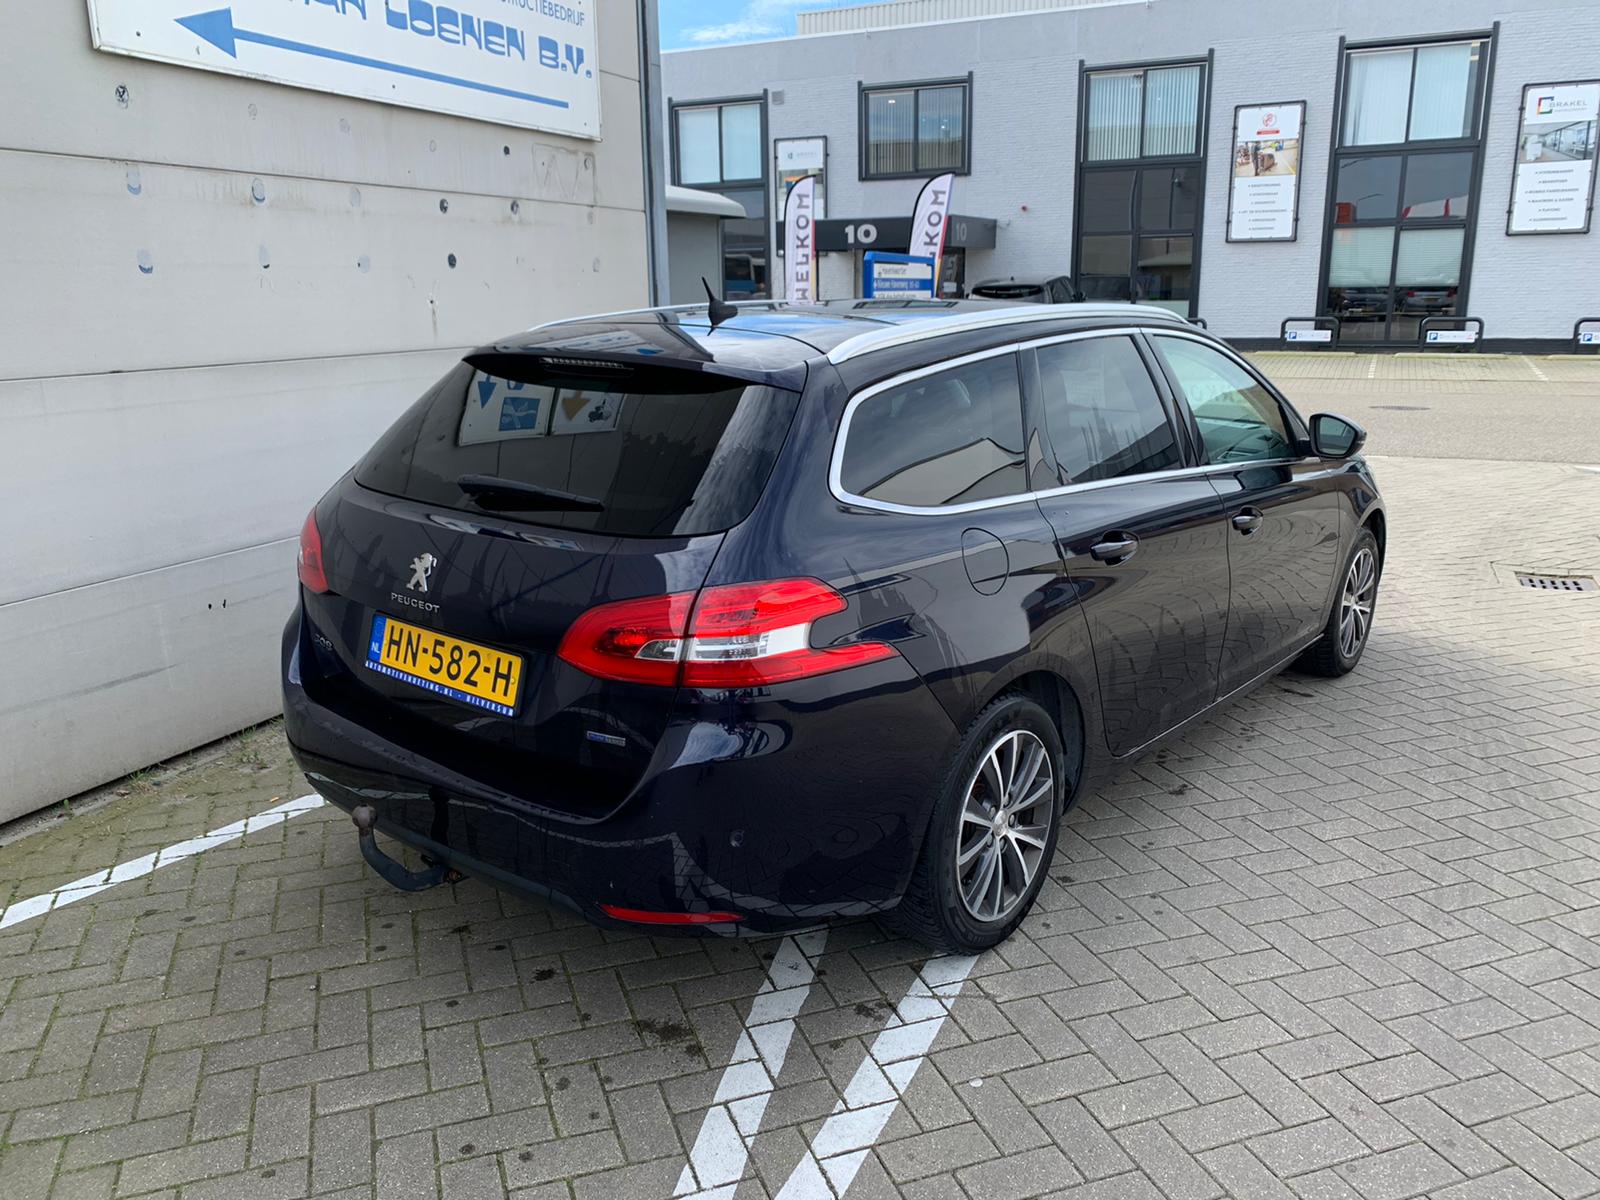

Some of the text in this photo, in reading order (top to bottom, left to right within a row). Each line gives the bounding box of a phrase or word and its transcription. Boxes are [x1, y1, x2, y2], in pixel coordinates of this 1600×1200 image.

[385, 0, 525, 61] LOENEN
[538, 36, 592, 78] B.V.
[844, 223, 878, 244] 10
[954, 222, 968, 241] 10
[795, 192, 811, 301] WELKOM
[390, 592, 441, 613] PEUGEOT
[370, 640, 381, 655] NL
[386, 625, 513, 698] HN-582-H
[466, 694, 514, 718] HILVERSUM
